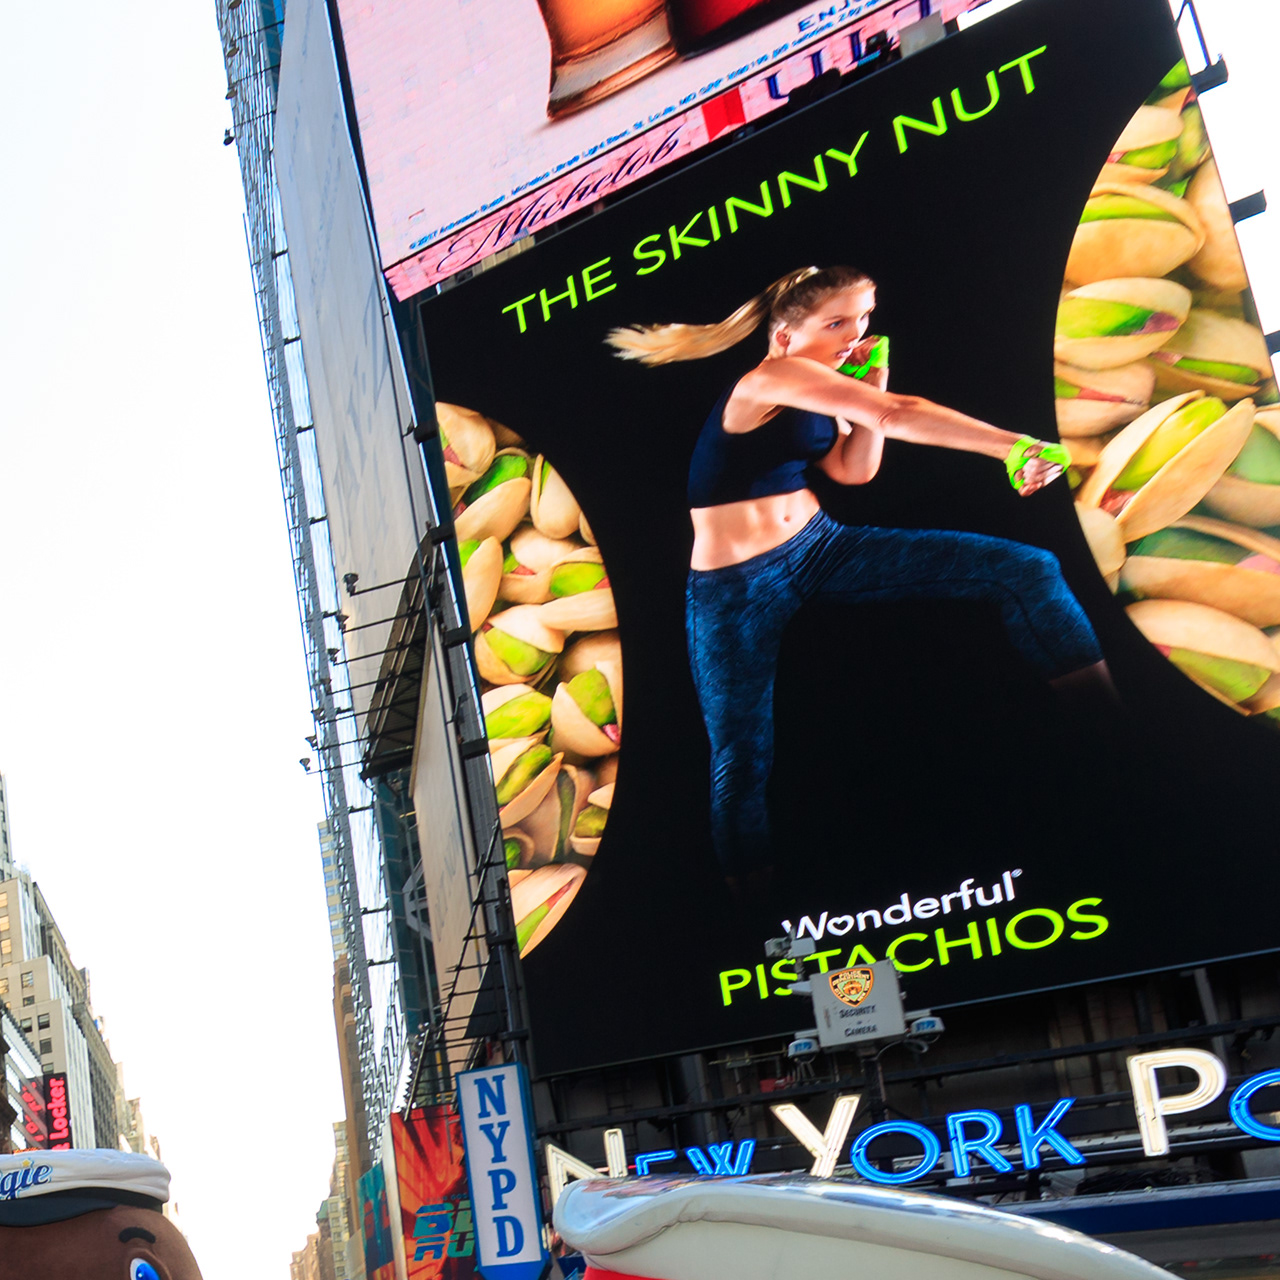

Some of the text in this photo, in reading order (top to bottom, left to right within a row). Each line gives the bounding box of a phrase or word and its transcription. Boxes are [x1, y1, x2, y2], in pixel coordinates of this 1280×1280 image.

[436, 124, 684, 273] Michelob
[501, 45, 1047, 333] THE SKINNY NUT
[719, 897, 1109, 1006] PISTACHIOS
[47, 1077, 70, 1140] Locker
[474, 1074, 524, 1258] NYPD
[770, 1094, 1090, 1186] YORK
